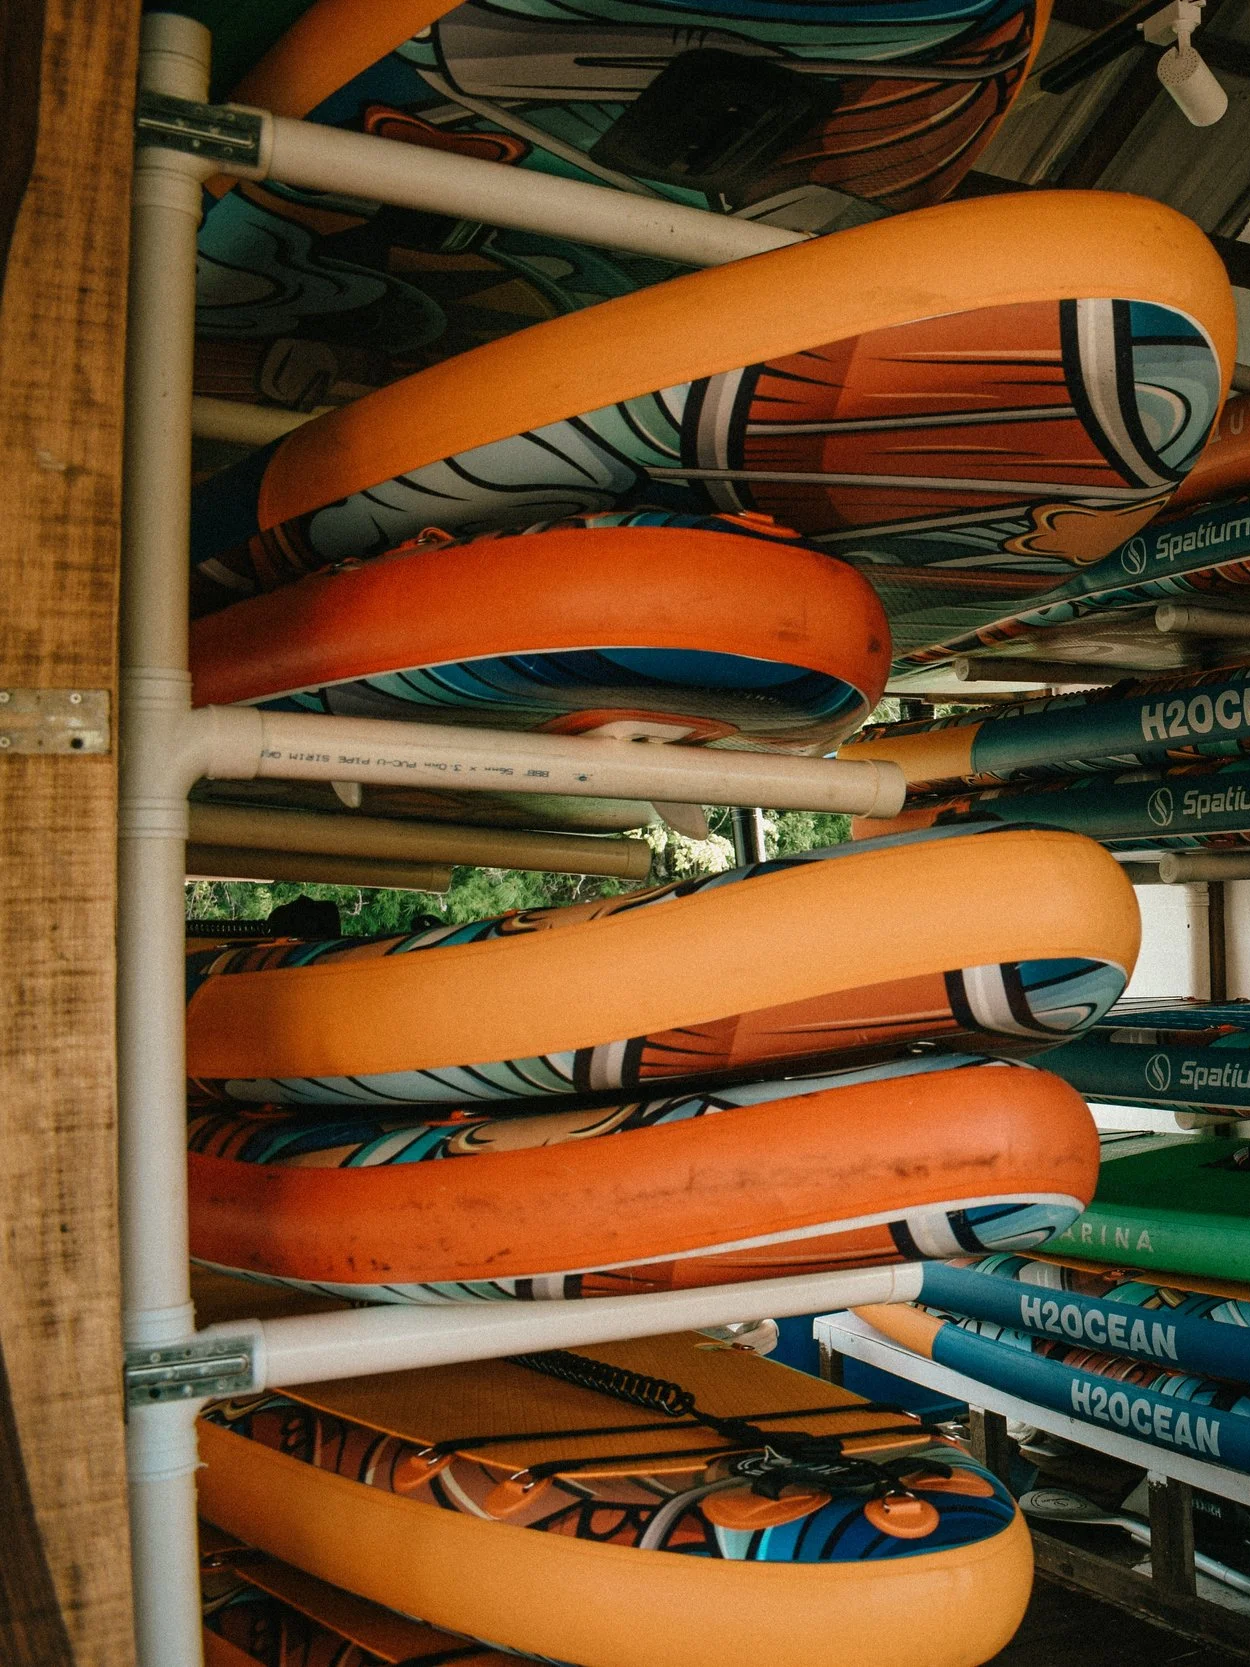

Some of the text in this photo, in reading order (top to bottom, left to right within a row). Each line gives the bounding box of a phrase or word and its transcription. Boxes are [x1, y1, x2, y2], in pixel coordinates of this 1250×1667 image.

[1155, 517, 1250, 562] Spatium
[289, 752, 330, 763] SIRIM
[338, 755, 370, 765] PIPE
[376, 758, 417, 769] PVC-U
[1020, 1294, 1178, 1360] H2OCEAN
[1071, 1378, 1220, 1456] H2OCEAN
